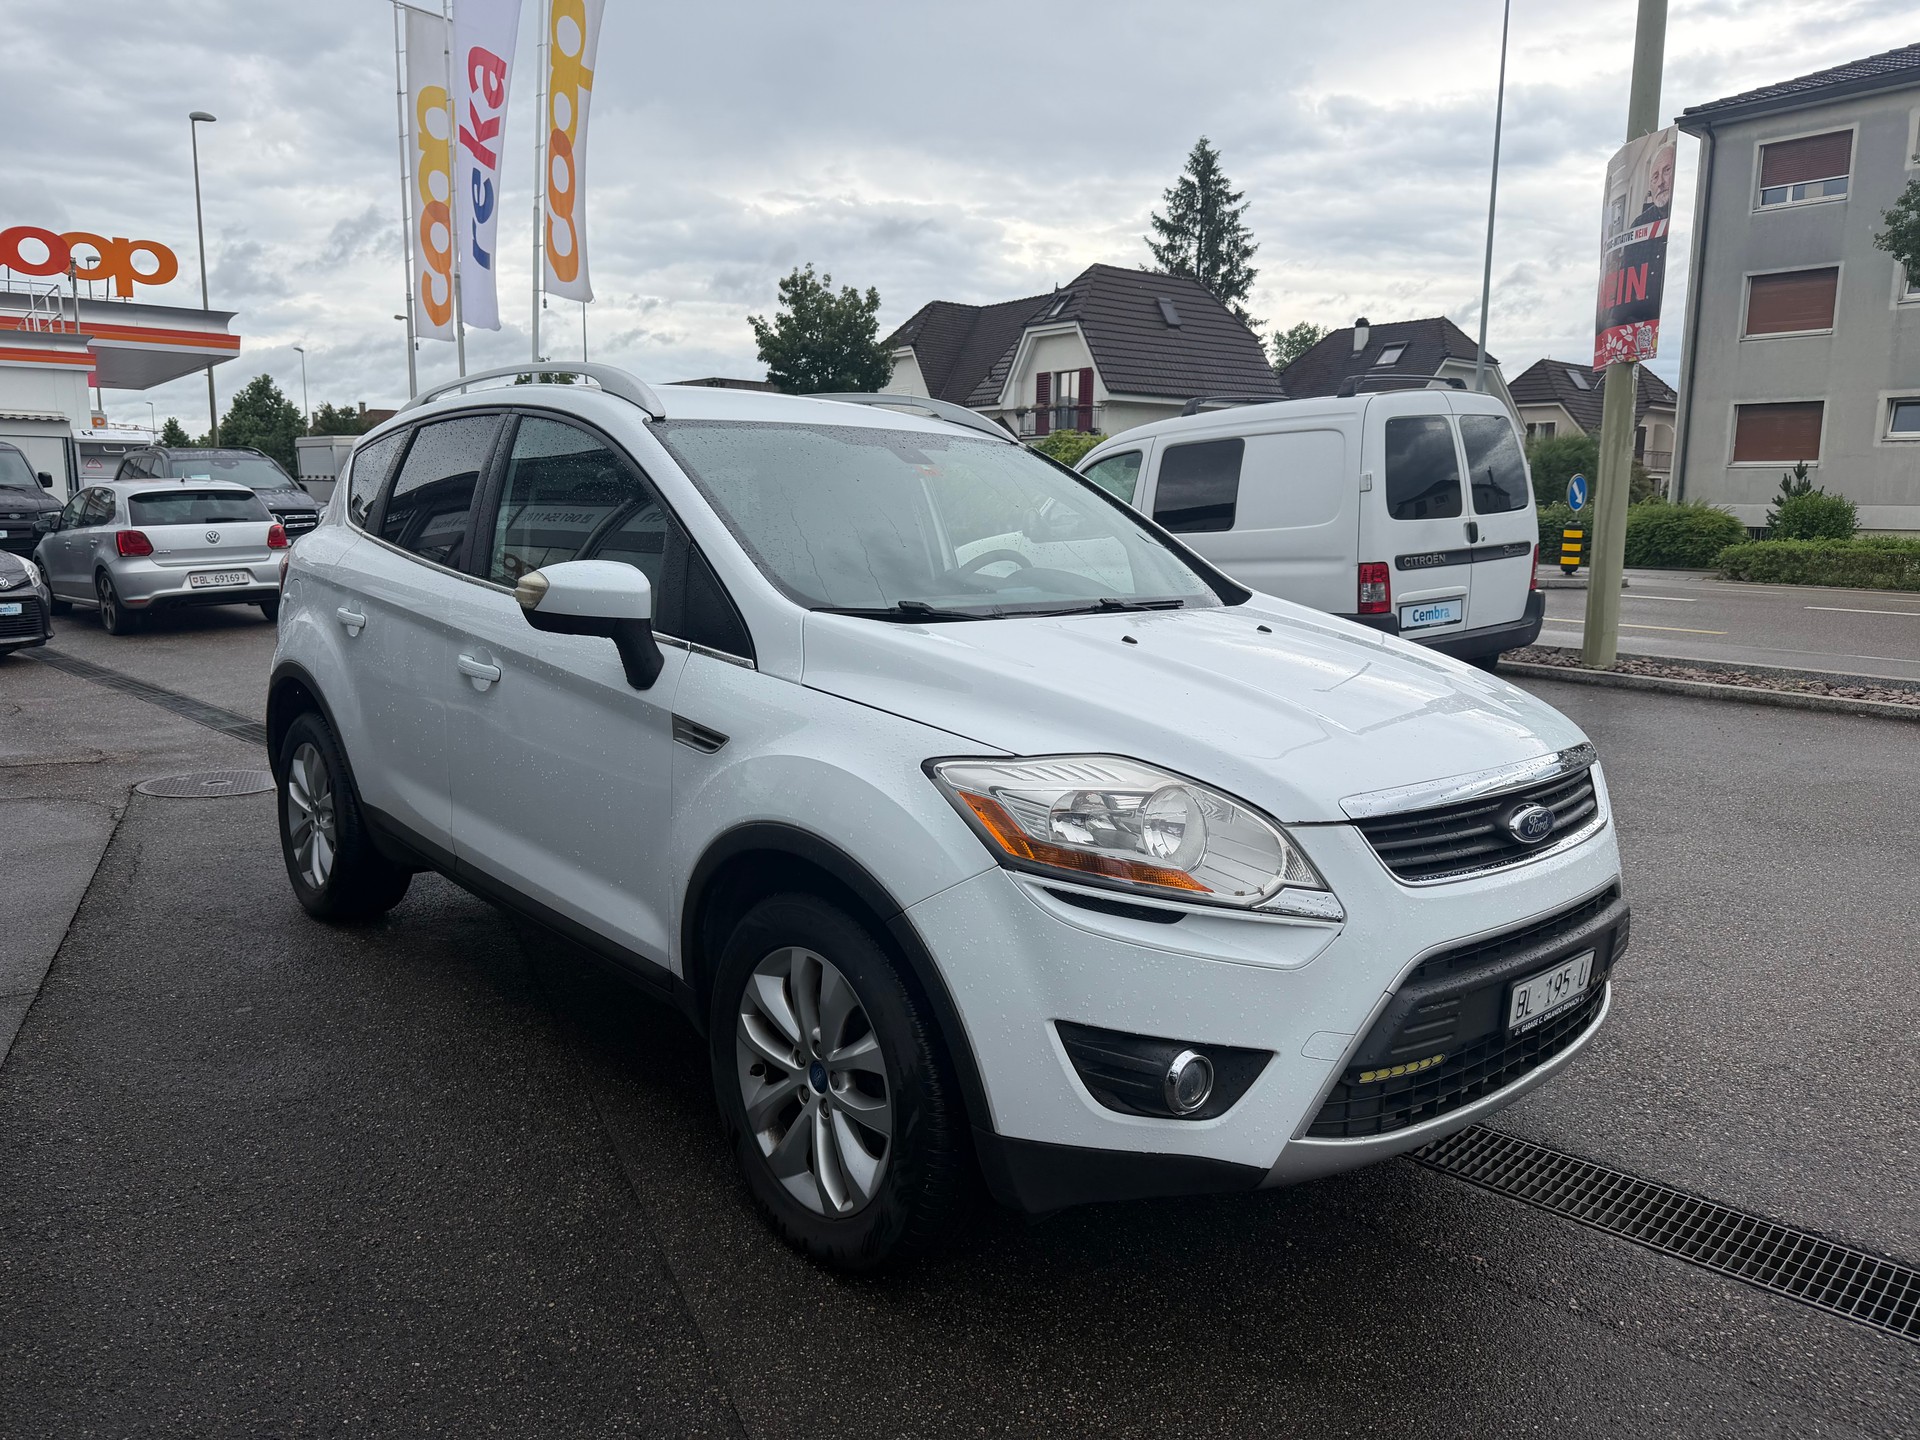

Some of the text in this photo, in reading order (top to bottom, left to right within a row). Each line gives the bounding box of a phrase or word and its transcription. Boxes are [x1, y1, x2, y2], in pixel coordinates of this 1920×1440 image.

[459, 46, 507, 270] reka
[547, 0, 593, 282] coop
[417, 85, 456, 326] coop
[0, 226, 178, 297] oop
[1403, 553, 1446, 567] CITROËN
[1412, 606, 1451, 622] Cembra
[1527, 812, 1549, 835] Ford
[1521, 1018, 1539, 1032] GARAGE
[1543, 1005, 1563, 1021] ORLANDO
